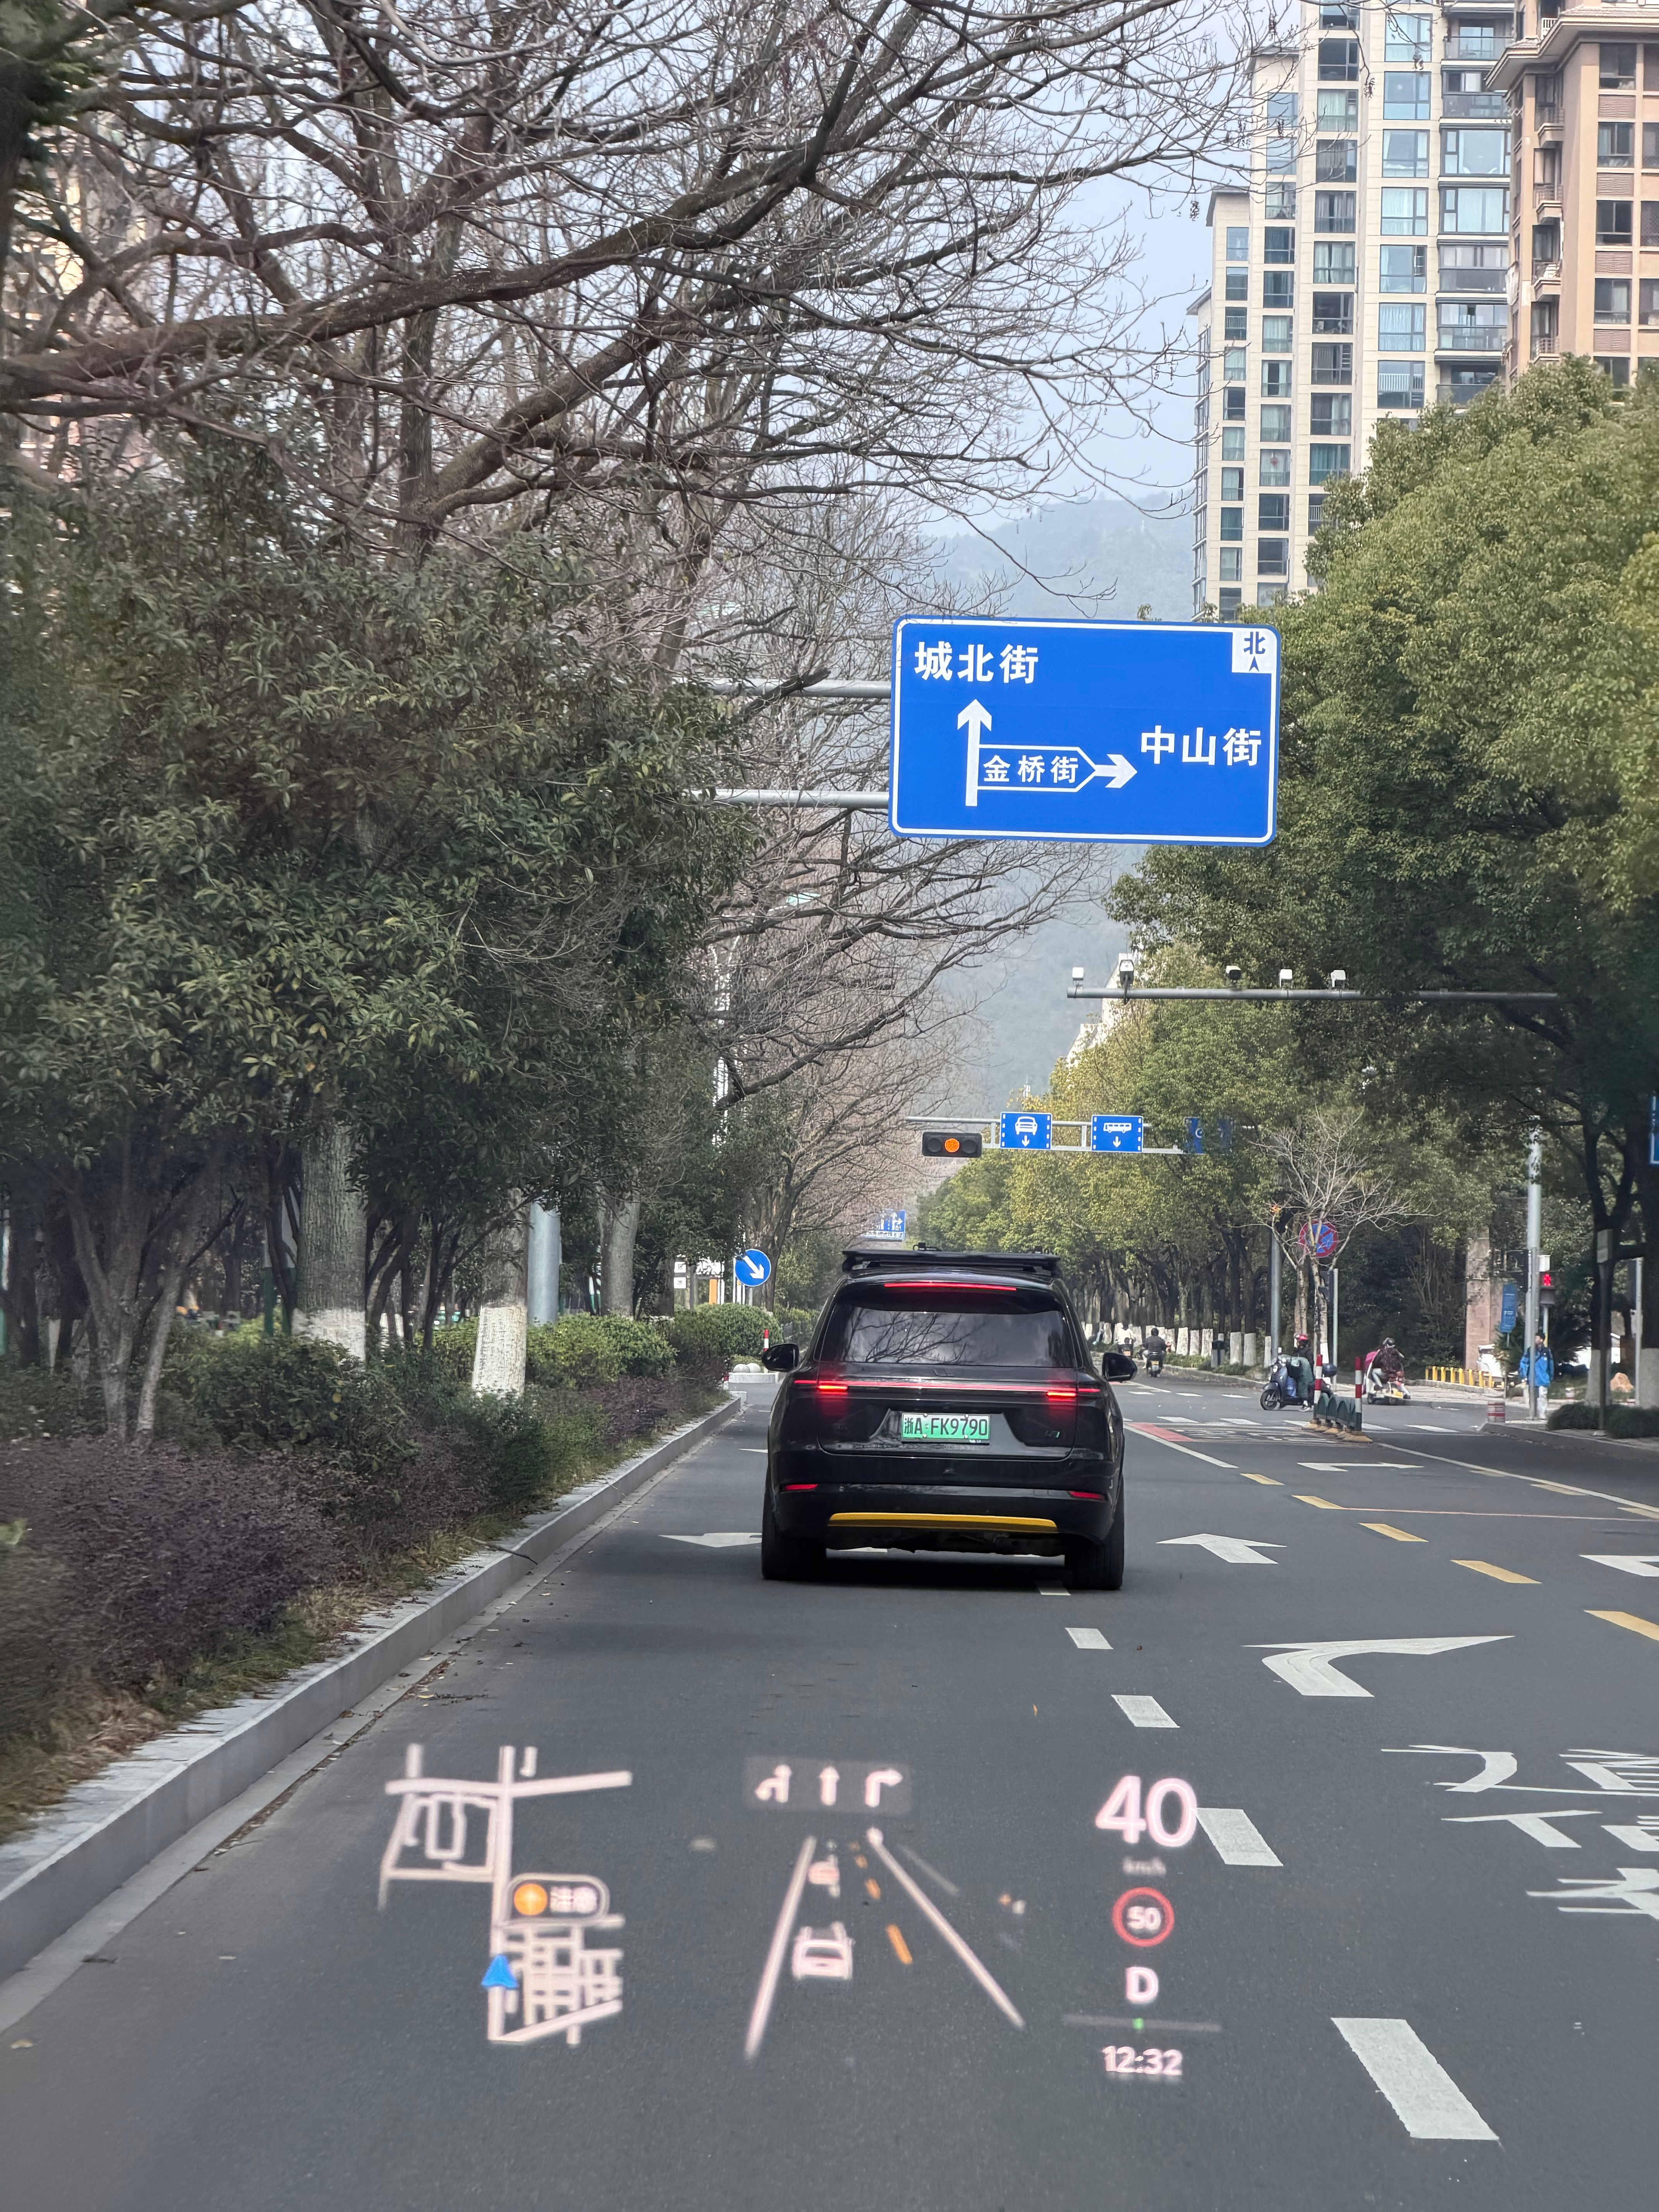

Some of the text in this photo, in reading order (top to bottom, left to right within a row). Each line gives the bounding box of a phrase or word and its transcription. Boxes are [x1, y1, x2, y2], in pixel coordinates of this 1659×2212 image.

[1244, 632, 1265, 654] 北
[914, 641, 1039, 684] 城北街
[1141, 725, 1262, 766] 中山街
[983, 755, 1079, 783] 金桥街
[1095, 1775, 1198, 1847] 40
[1127, 1906, 1161, 1930] 50
[1125, 1966, 1159, 2004] D
[1102, 2045, 1183, 2076] 12:32
